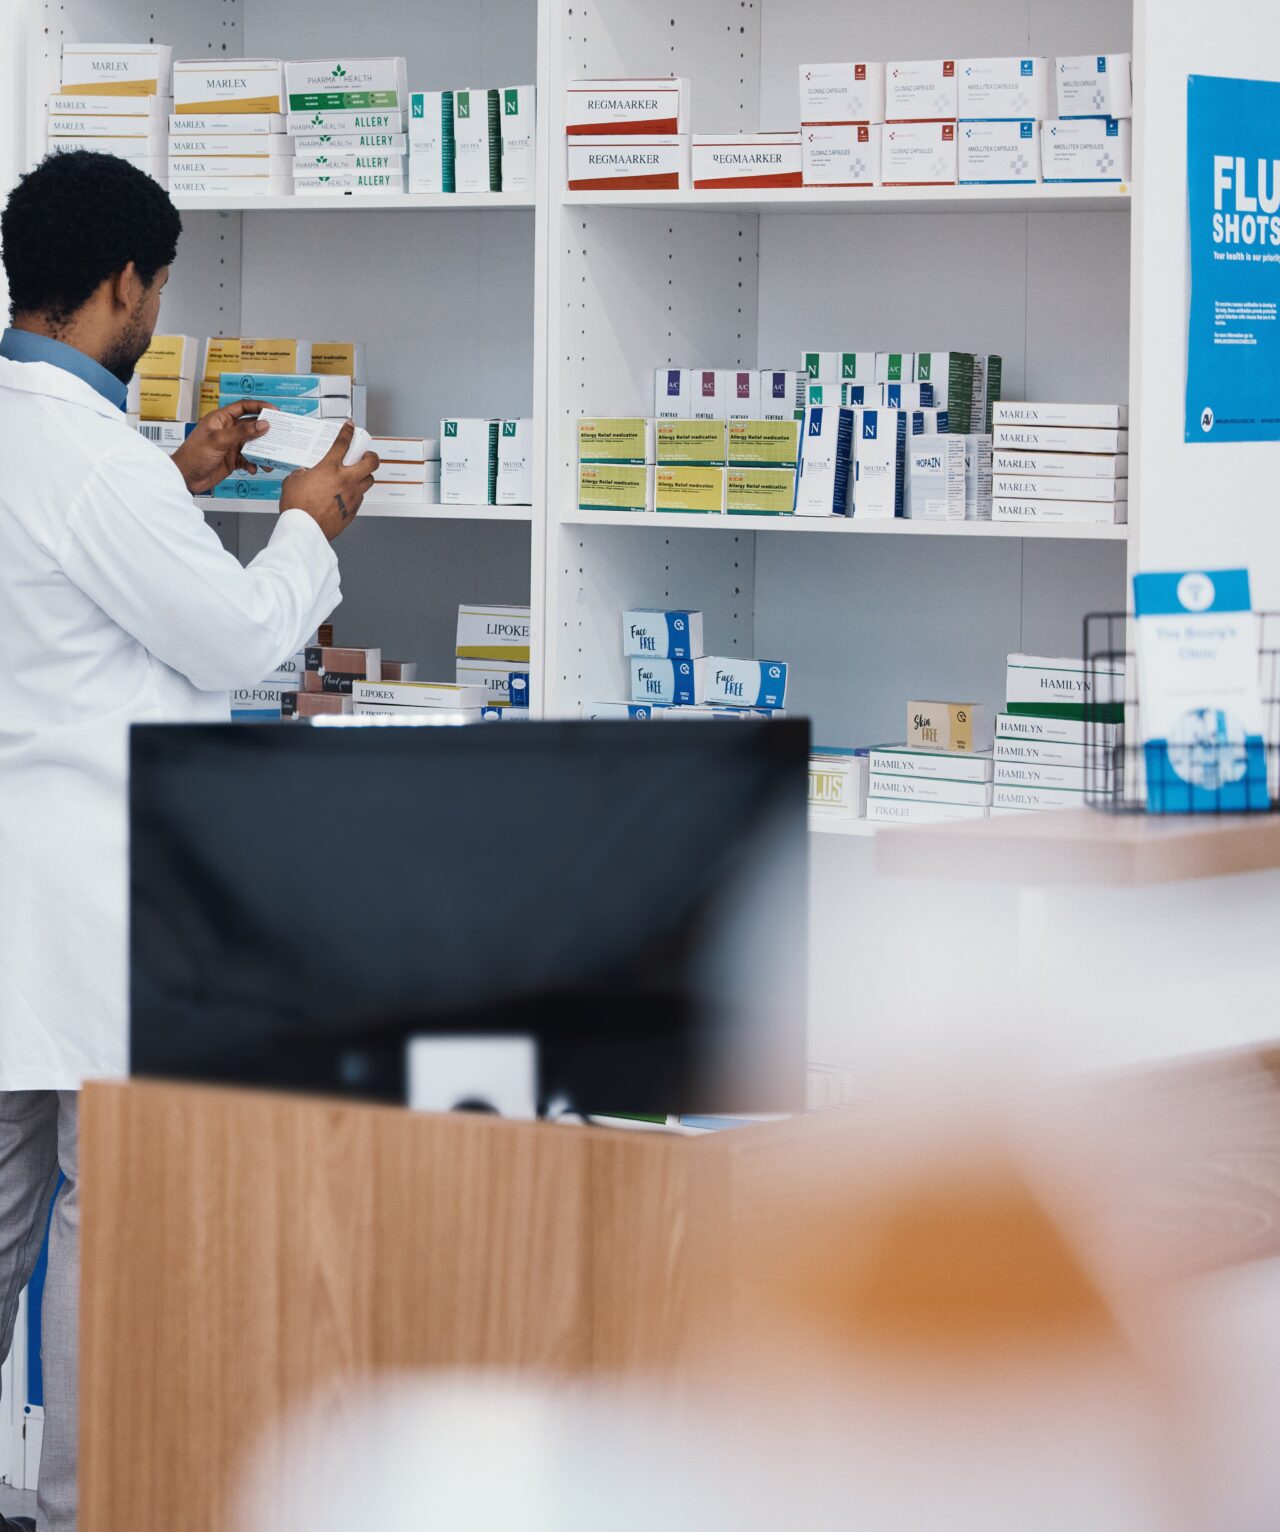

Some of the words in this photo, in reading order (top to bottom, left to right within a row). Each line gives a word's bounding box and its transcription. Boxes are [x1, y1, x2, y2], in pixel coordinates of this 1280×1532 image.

[92, 62, 128, 71] MARLEX
[207, 79, 247, 88] MARLEX
[55, 102, 85, 110] MARLEX
[413, 105, 422, 114] N
[459, 105, 467, 114] N
[507, 102, 515, 111] N
[588, 100, 658, 110] REGMAARKER
[53, 122, 85, 130] MARLEX
[355, 117, 388, 128] ALLERY
[360, 136, 393, 146] ALLERY
[356, 158, 388, 168] ALLERY
[589, 155, 659, 164] REGMAARKER
[713, 154, 782, 164] REGMAARKER
[358, 176, 390, 186] ALLERY
[1214, 155, 1280, 214] FLU
[1212, 212, 1280, 246] SHOTS
[1214, 251, 1225, 260] Your
[1227, 252, 1244, 261] health
[1246, 253, 1251, 261] is
[808, 365, 817, 375] N
[844, 365, 853, 375] N
[920, 367, 928, 376] N
[999, 410, 1038, 419] MARLEX
[447, 424, 455, 433] N
[505, 424, 513, 433] N
[811, 423, 820, 432] N
[865, 426, 874, 435] N
[1000, 434, 1039, 443] MARLEX
[998, 459, 1037, 469] MARLEX
[999, 483, 1037, 492] MARLEX
[998, 506, 1037, 515] MARLEX
[487, 624, 529, 637] LIPOKE
[631, 625, 646, 638] Face
[640, 637, 656, 650] FREE
[638, 668, 653, 682] Face
[716, 671, 735, 685] Face
[647, 681, 662, 694] FREE
[725, 682, 744, 697] FREE
[1040, 678, 1091, 692] HAMILYN
[360, 690, 395, 700] LIPOKEX
[914, 714, 931, 730] Skin
[1000, 723, 1043, 733] HAMILYN
[922, 728, 937, 743] FREE
[997, 746, 1039, 757] HAMILYN
[873, 759, 914, 770] HAMILYN
[998, 769, 1040, 780] HAMILYN
[873, 782, 914, 793] HAMILYN
[998, 794, 1040, 804] HAMILYN
